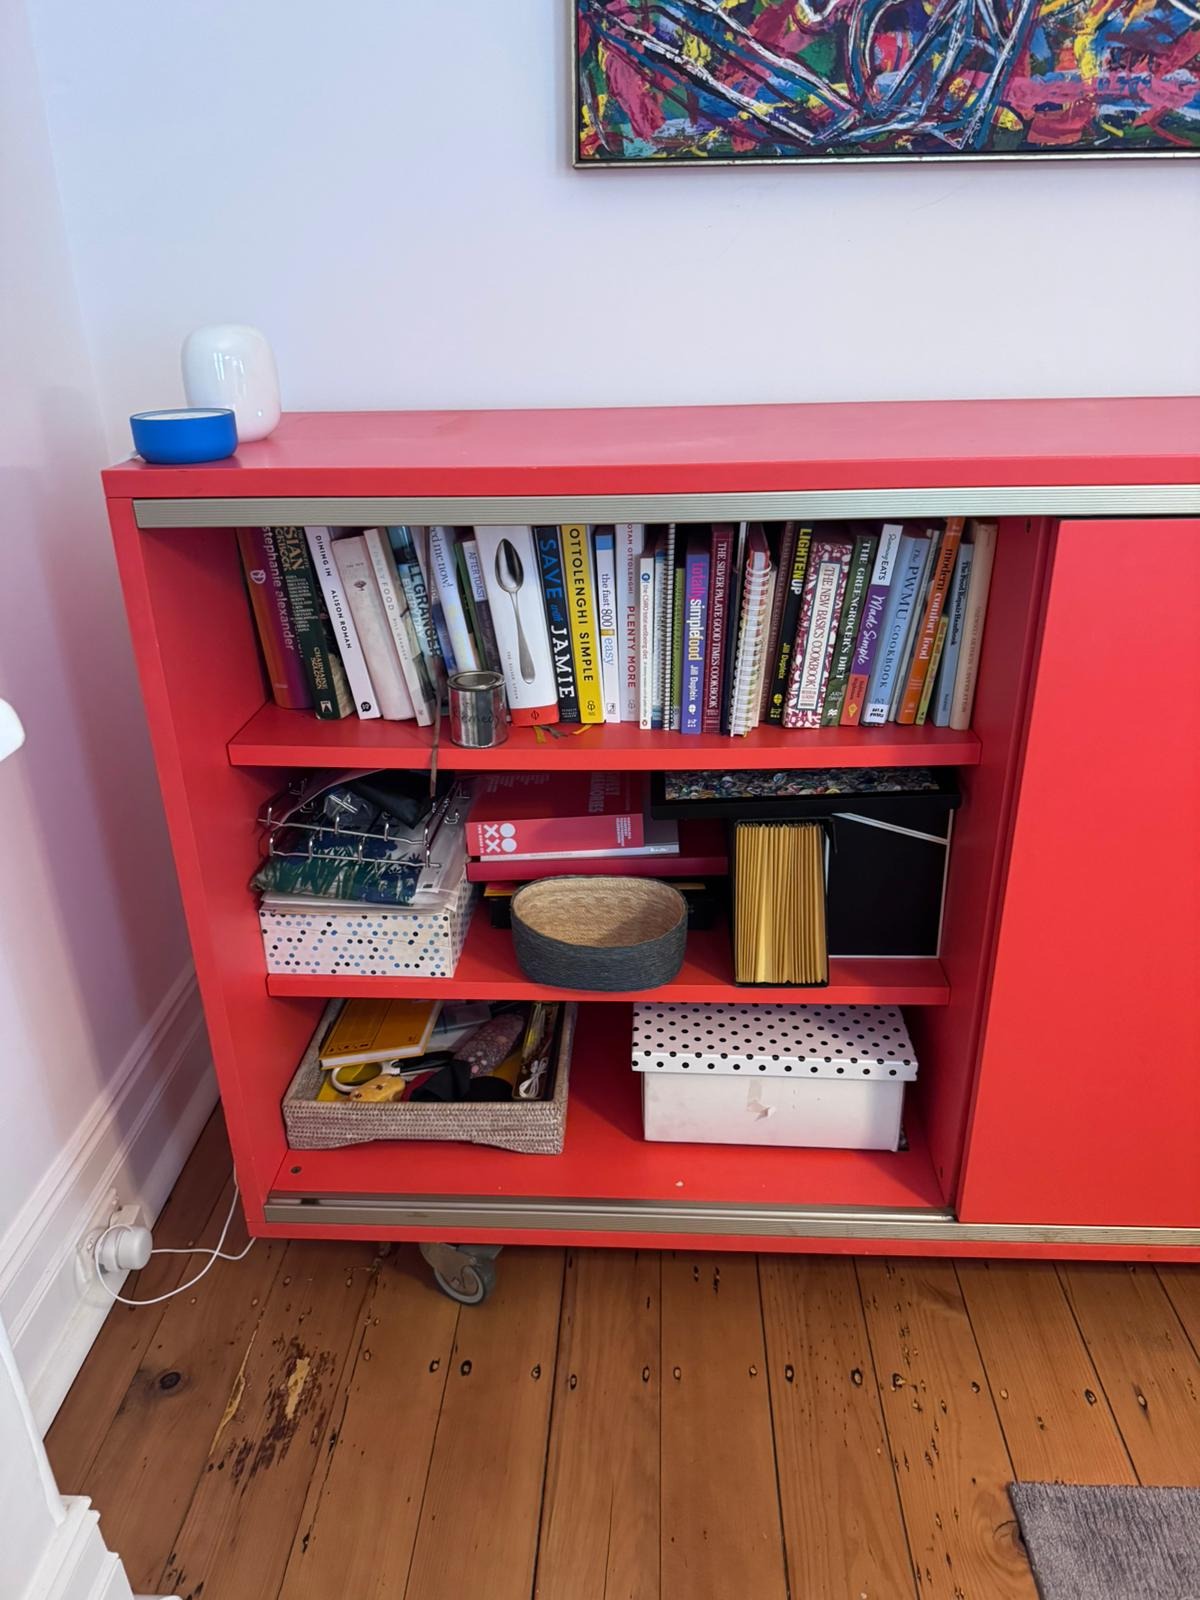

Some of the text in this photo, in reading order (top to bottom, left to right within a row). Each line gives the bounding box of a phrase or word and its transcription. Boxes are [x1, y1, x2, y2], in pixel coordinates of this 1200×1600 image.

[284, 527, 305, 570] SIAN
[434, 543, 444, 561] me
[717, 542, 727, 560] THE
[438, 561, 454, 588] now!
[468, 551, 485, 599] AFTER TOAST
[541, 539, 562, 598] SAVE
[627, 547, 635, 595] OTTOLENGHI
[715, 561, 726, 587] SILVER
[822, 566, 835, 587] THE
[878, 561, 889, 581] EATS
[937, 549, 953, 590] modern
[962, 561, 970, 573] The
[262, 526, 295, 650] stephanie alexander
[315, 535, 353, 649] DINING IN ALISON ROMAN
[959, 573, 969, 591] Food
[569, 528, 594, 682] OTTOLENGHI SIMPLE
[602, 590, 611, 606] fast
[713, 588, 725, 617] PALATE
[818, 588, 831, 609] NEW
[835, 541, 871, 681] THE GREENGROCER'S DIET
[866, 594, 886, 629] Made
[601, 608, 613, 628] 800
[814, 609, 828, 638] BASICS
[880, 548, 921, 689] The PWMU COOKBOOK
[925, 592, 942, 634] comfort
[626, 606, 636, 651] PLENTY
[713, 618, 723, 641] GOOD
[551, 624, 575, 698] JAMIE
[604, 637, 615, 666] easy
[711, 642, 721, 667] TIMES
[782, 642, 790, 653] Jill
[857, 630, 877, 665] Simple
[919, 637, 934, 660] food
[627, 656, 636, 689] MORE
[690, 665, 698, 675] Jill
[805, 641, 823, 687] COOKBOOK
[708, 667, 720, 708] COOKBOOK
